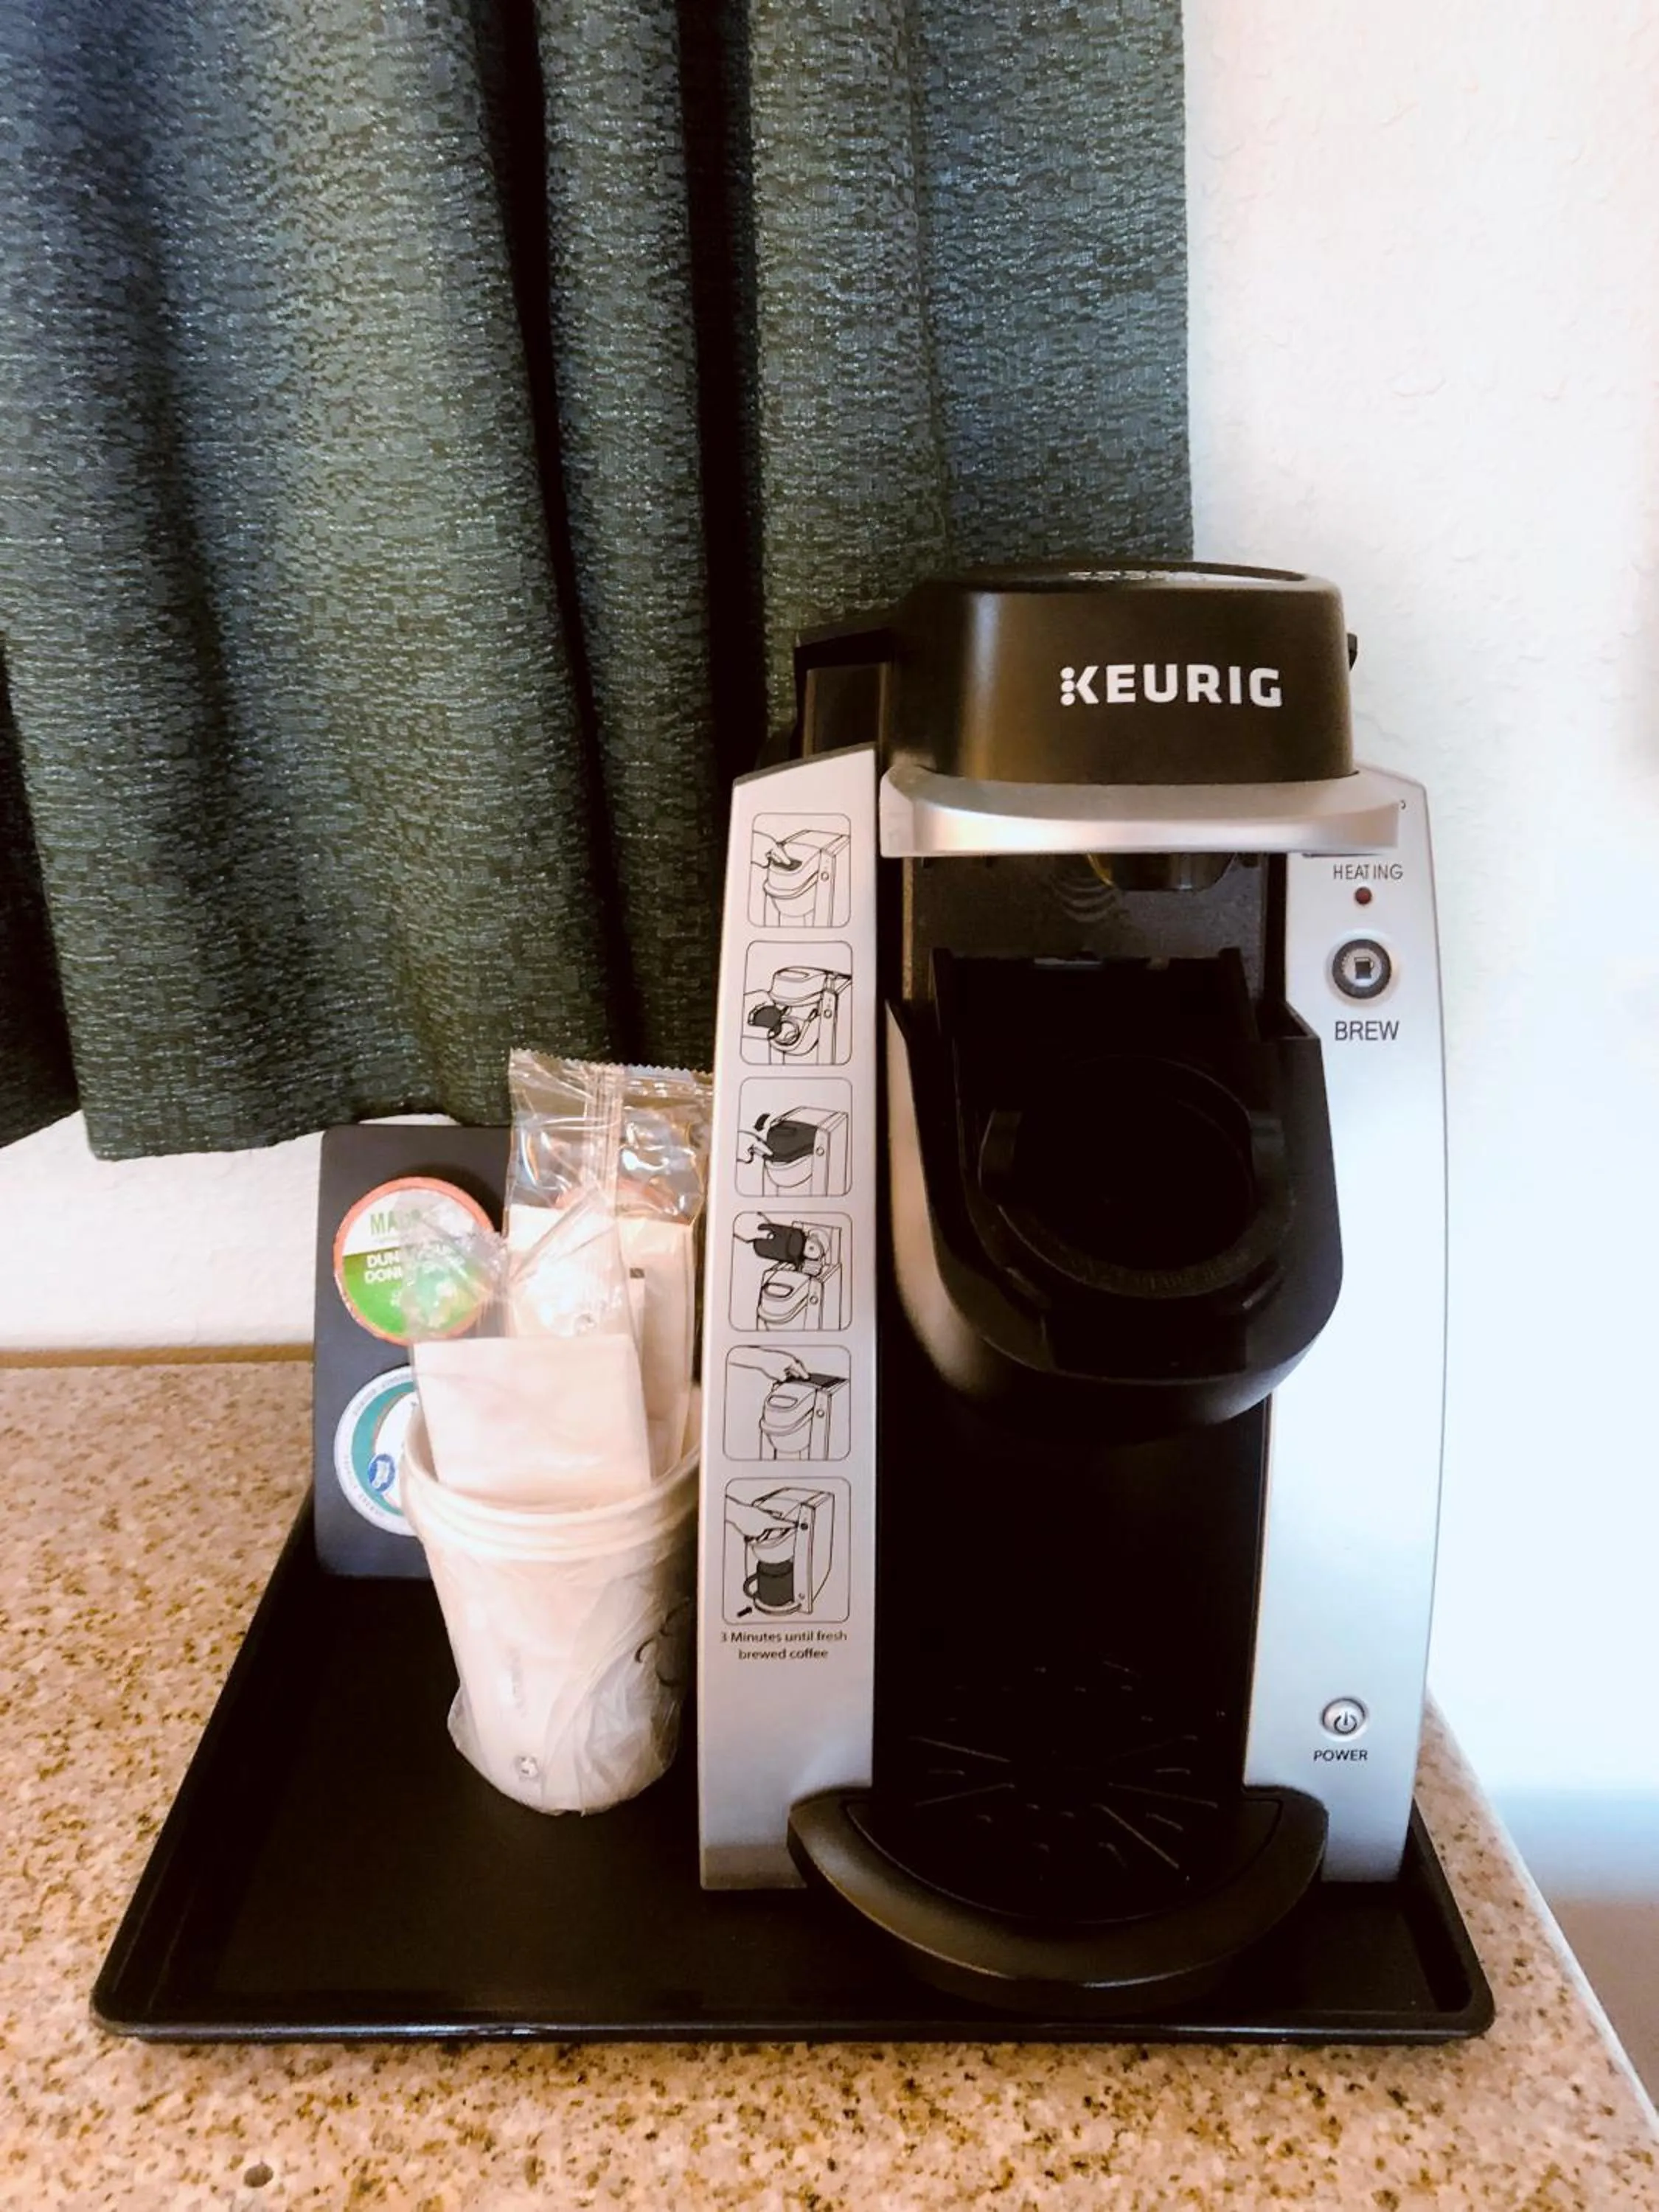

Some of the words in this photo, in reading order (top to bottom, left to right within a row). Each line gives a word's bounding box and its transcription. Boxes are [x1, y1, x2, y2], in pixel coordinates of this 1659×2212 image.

[1060, 664, 1283, 708] KEURIG
[1333, 863, 1404, 880] HEATING
[1335, 1020, 1400, 1041] BREW
[721, 1631, 728, 1643] 3
[730, 1631, 782, 1643] Minutes
[785, 1630, 813, 1642] until
[816, 1630, 848, 1642] fresh
[738, 1648, 787, 1660] brewed
[789, 1647, 828, 1660] coffee
[1313, 1749, 1368, 1762] POWER
